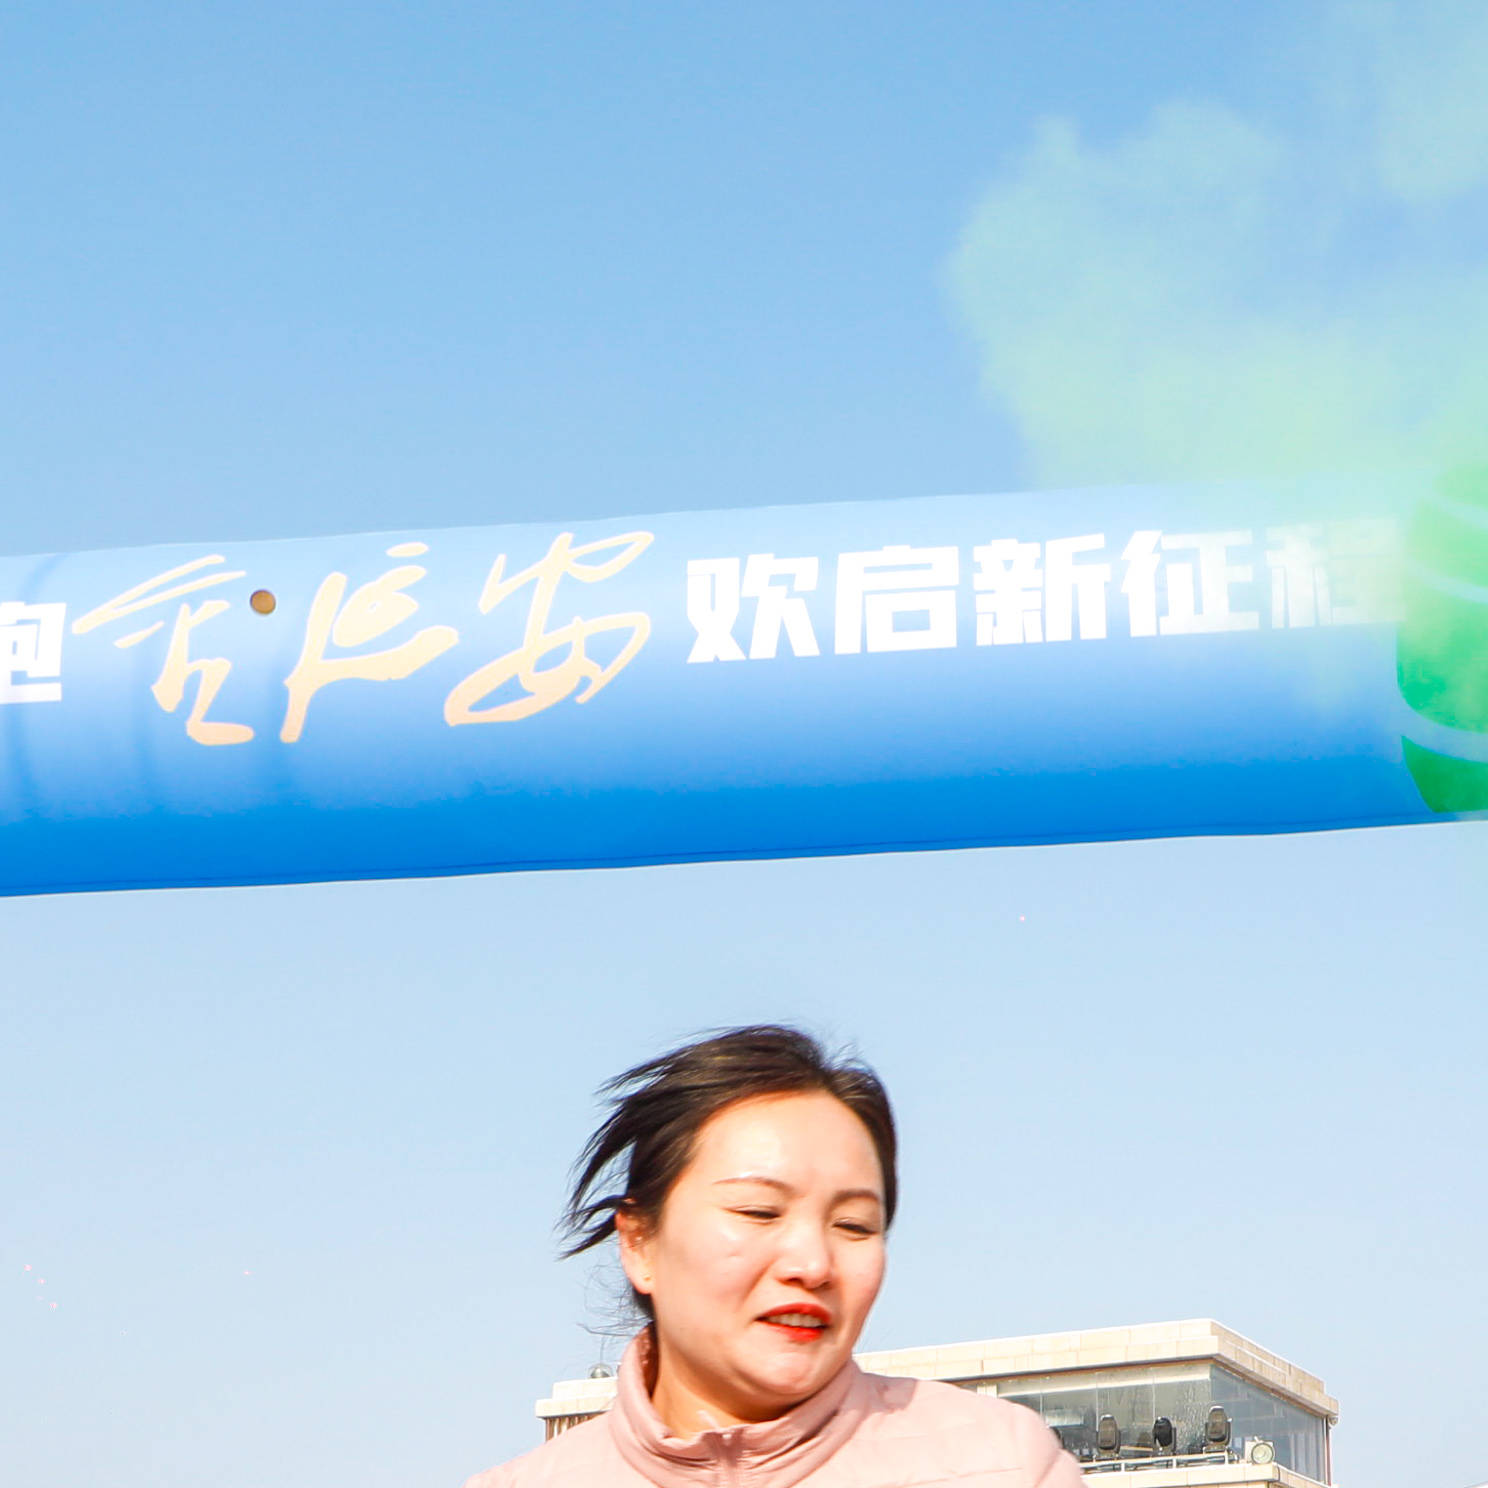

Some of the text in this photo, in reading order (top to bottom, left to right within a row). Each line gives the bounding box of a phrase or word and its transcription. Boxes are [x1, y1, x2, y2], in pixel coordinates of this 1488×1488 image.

[685, 514, 1408, 664] 欢启新征程
